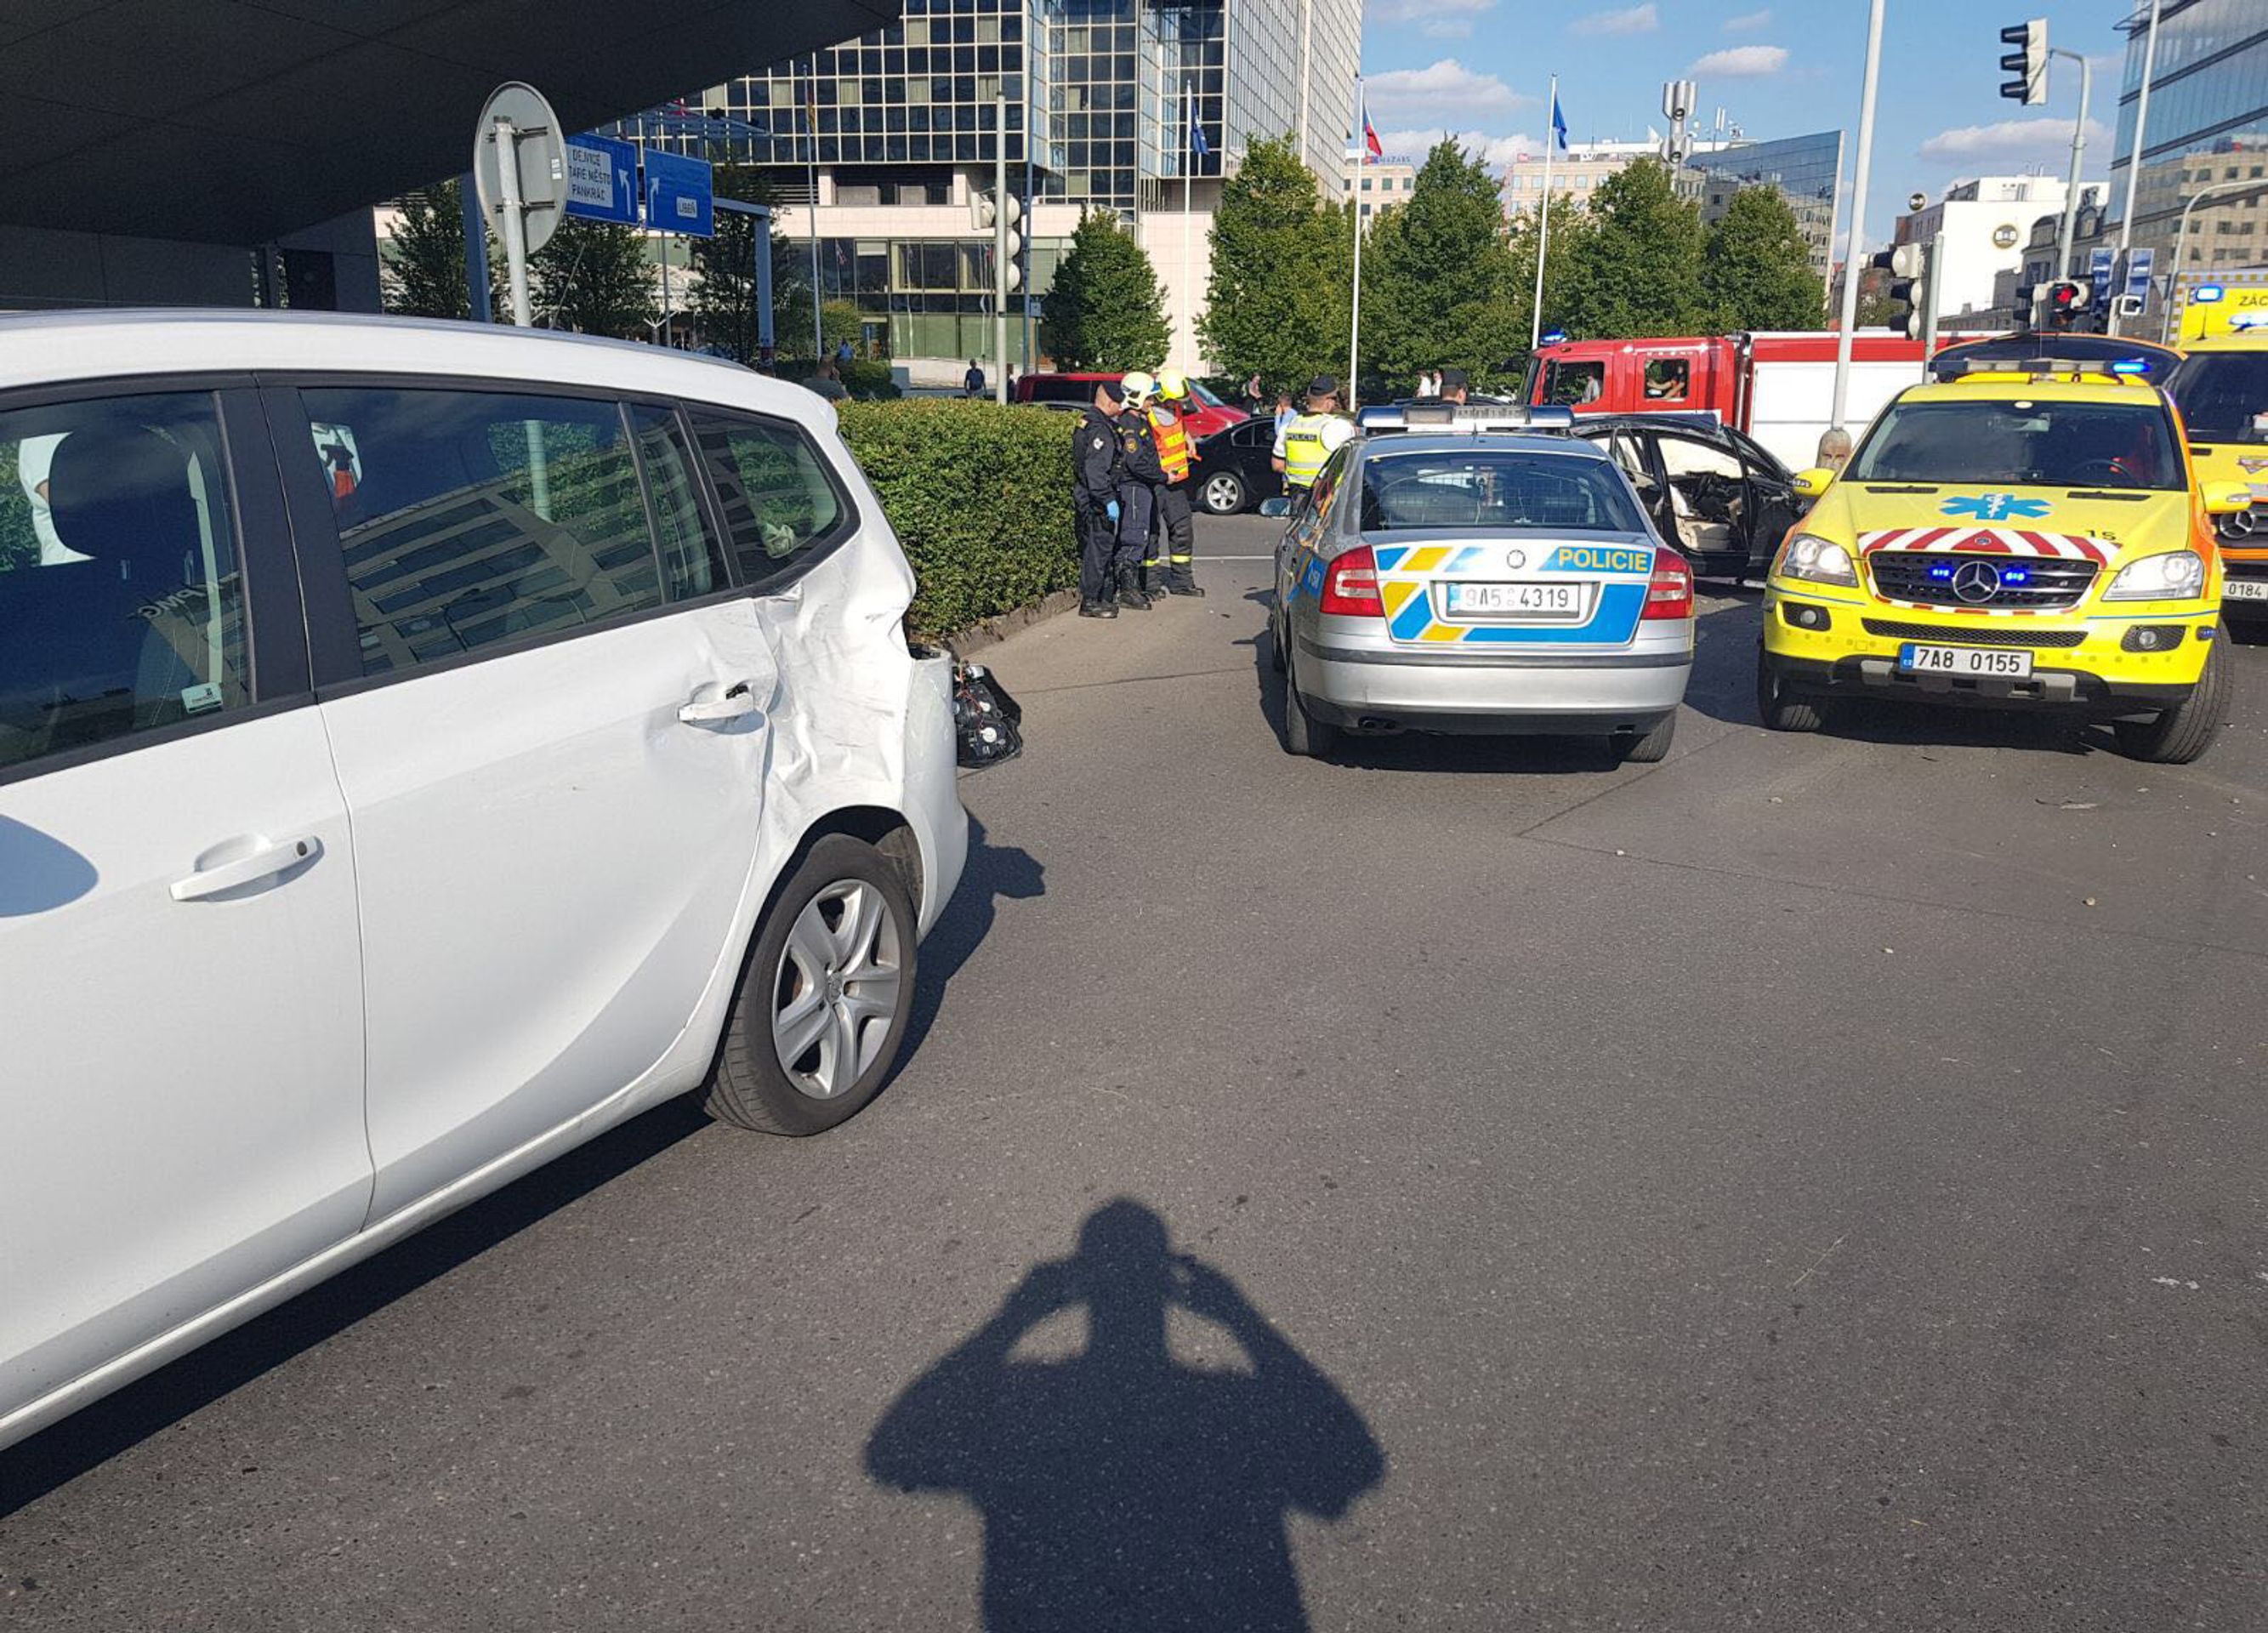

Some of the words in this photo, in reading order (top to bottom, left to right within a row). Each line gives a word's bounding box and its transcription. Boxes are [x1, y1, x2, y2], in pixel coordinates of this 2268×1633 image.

[572, 149, 600, 166] DEJVICE
[567, 165, 587, 179] TARE
[2085, 529, 2117, 541] 15
[1558, 549, 1649, 572] POLICIE
[2229, 582, 2262, 596] 0184
[1465, 588, 1501, 607] 9A5
[1521, 588, 1569, 608] 4319
[1918, 649, 1954, 669] 7A8
[1970, 653, 2021, 674] 0155
